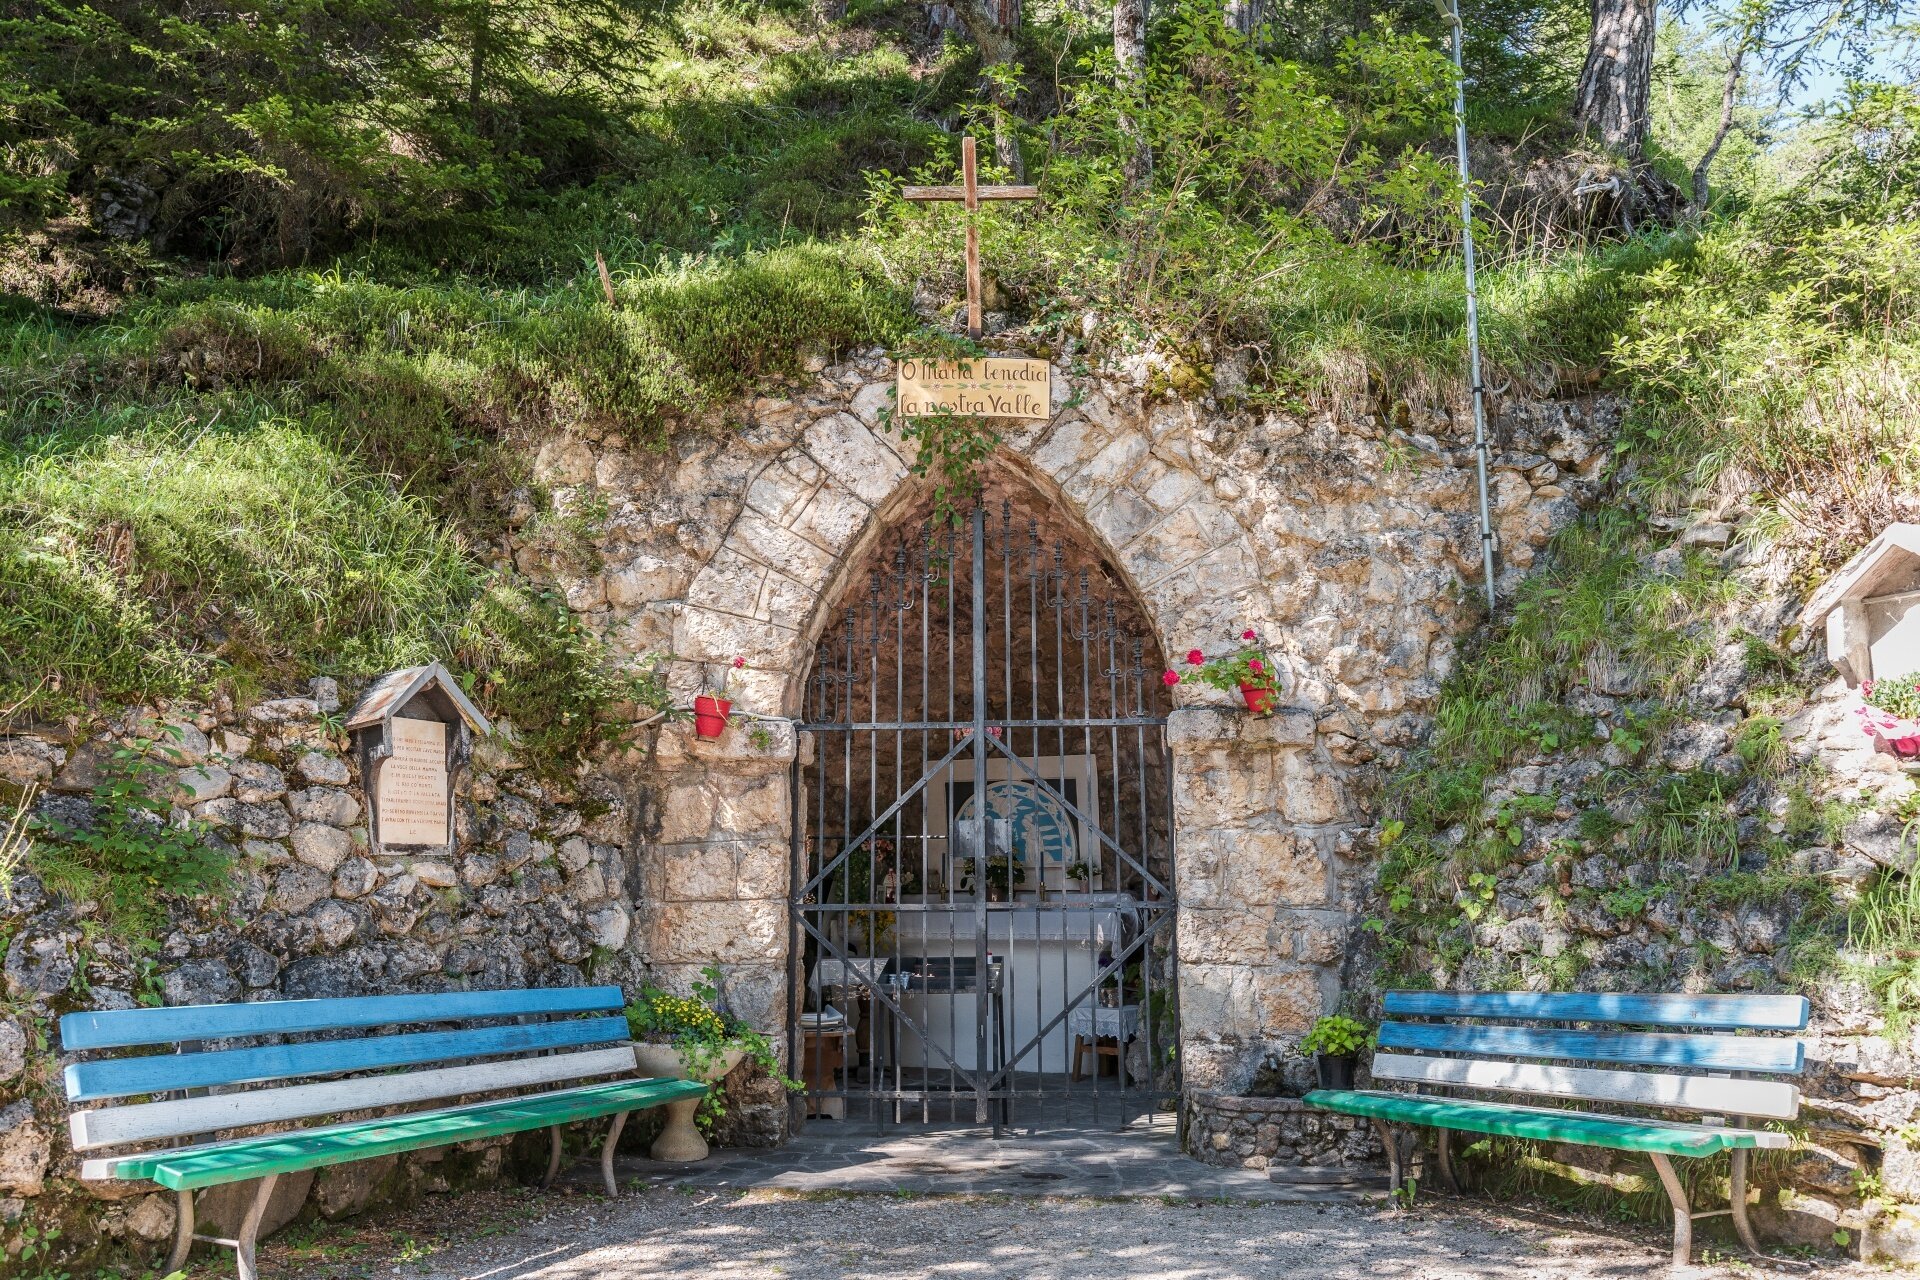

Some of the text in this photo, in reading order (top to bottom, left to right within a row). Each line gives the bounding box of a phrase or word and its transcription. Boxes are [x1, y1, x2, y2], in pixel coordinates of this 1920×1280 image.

[902, 360, 1048, 382] O Maria benedici
[900, 393, 1042, 416] la nostra Valle
